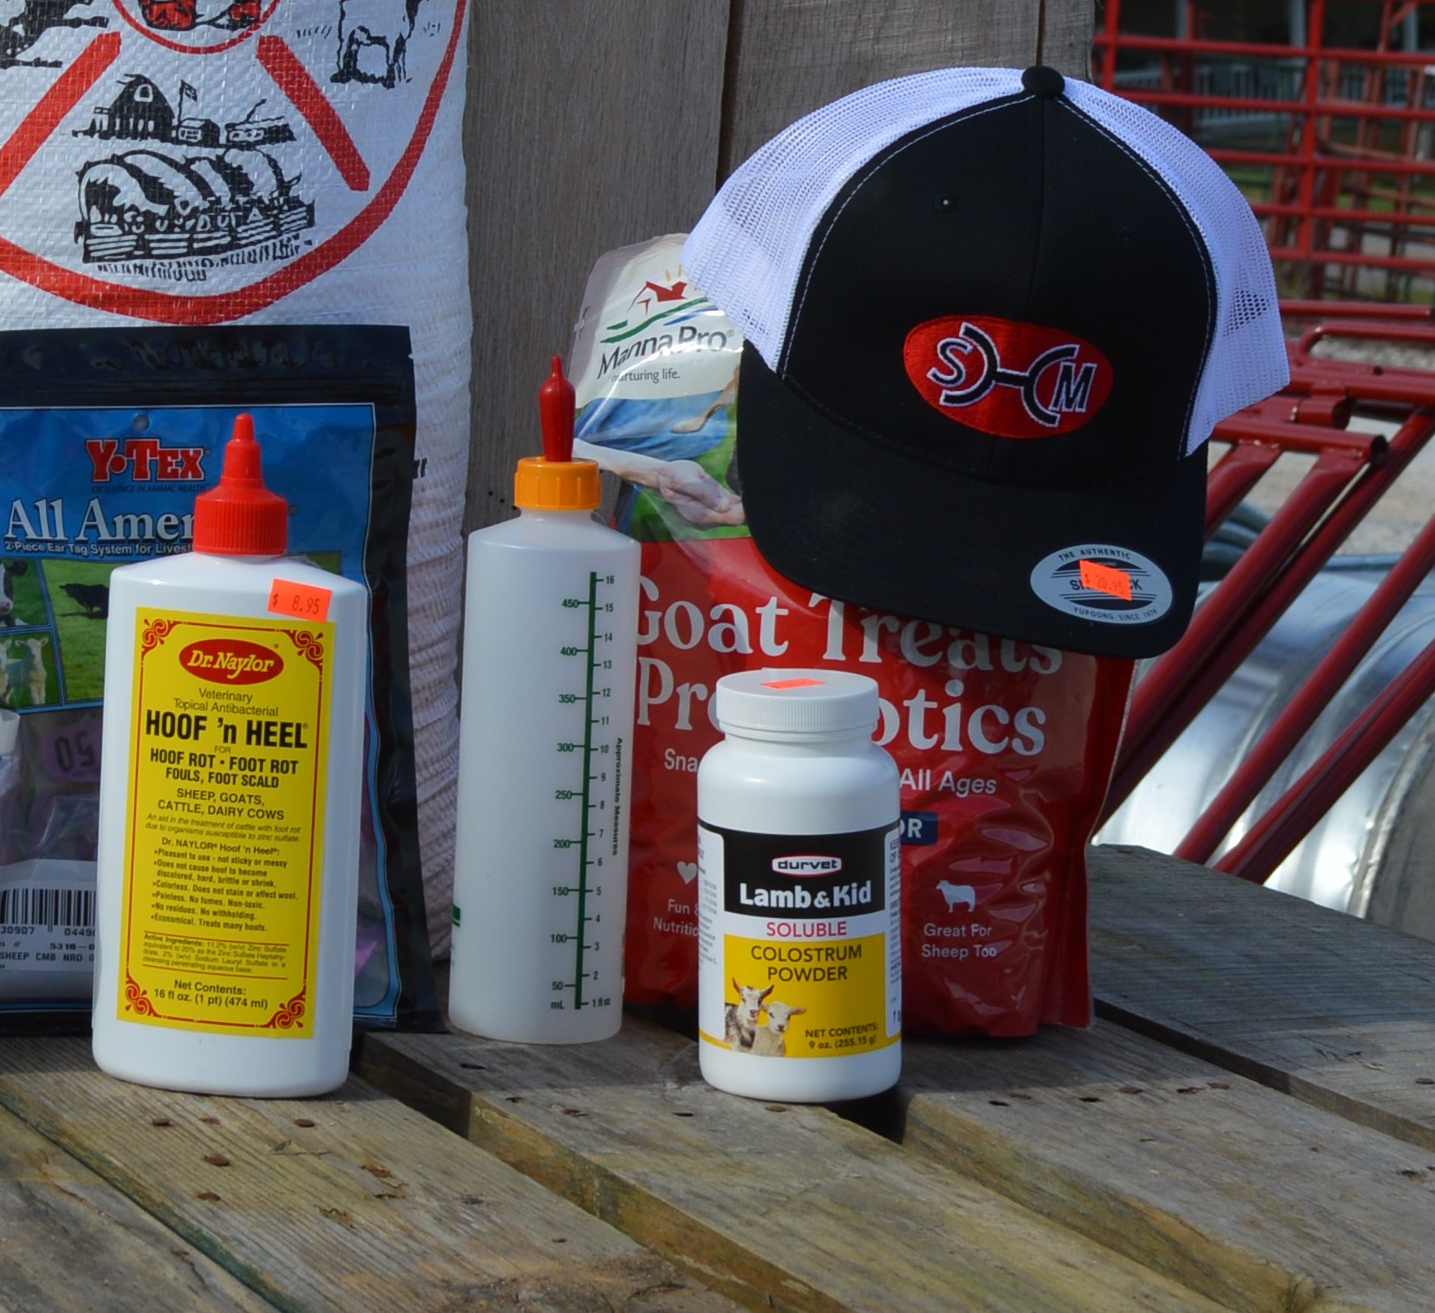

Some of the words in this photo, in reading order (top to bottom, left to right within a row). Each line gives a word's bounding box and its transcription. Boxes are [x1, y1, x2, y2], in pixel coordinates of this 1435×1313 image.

[597, 332, 672, 380] Manna
[677, 325, 727, 352] Pro
[662, 367, 680, 381] life.
[3, 498, 69, 541] All
[5, 540, 45, 553] 2-Piece
[47, 541, 65, 553] Ear
[68, 544, 88, 556] Tag
[90, 544, 132, 556] System
[135, 543, 152, 555] for
[1058, 550, 1076, 561] THE
[1080, 547, 1131, 560] AUTHENTIC
[605, 575, 615, 585] 16
[272, 592, 279, 607] $
[291, 594, 321, 616] 8.95
[561, 598, 580, 609] 450
[605, 602, 614, 612] 15
[1073, 606, 1114, 621] YUPOONG
[1118, 612, 1140, 622] SINCE
[604, 632, 613, 642] 14
[809, 593, 1063, 675] Treats
[560, 646, 578, 657] 400
[187, 646, 213, 668] Dr.
[213, 651, 275, 680] Naylor
[603, 659, 612, 669] 13
[199, 688, 253, 704] Veterinary
[558, 693, 577, 704] 350
[602, 688, 611, 698] 12
[173, 698, 208, 712] Topical
[210, 702, 279, 717] Antibacterial
[601, 716, 610, 726] 11
[146, 709, 207, 741] HOOF
[246, 720, 307, 749] HEEL
[214, 745, 231, 755] FOR
[557, 742, 574, 753] 300
[600, 744, 609, 754] 10
[150, 747, 184, 766] HOOF
[189, 752, 215, 769] ROT
[229, 756, 266, 773] FOOT
[270, 759, 299, 775] ROT
[614, 737, 623, 804] Approximate
[166, 767, 204, 785] FOULS,
[208, 771, 238, 786] FOOT
[241, 774, 280, 789] SCALD
[600, 771, 606, 782] 9
[900, 768, 931, 791] All
[938, 770, 997, 798] Ages
[177, 788, 216, 803] SHEEP,
[220, 792, 265, 807] GOATS,
[555, 789, 573, 800] 250
[158, 799, 205, 816] CATTLE,
[207, 805, 244, 818] DAIRY
[247, 808, 285, 821] COWS
[599, 799, 605, 810] 8
[598, 828, 604, 839] 7
[612, 805, 621, 856] Measures
[553, 838, 571, 849] 200
[597, 856, 603, 867] 6
[778, 859, 838, 870] durvet
[551, 886, 569, 896] 150
[596, 886, 602, 896] 5
[668, 898, 691, 915] Fun
[595, 913, 601, 923] 4
[767, 920, 847, 938] SOLUBLE
[924, 922, 967, 937] Great
[971, 923, 992, 937] For
[550, 933, 567, 944] 100
[594, 941, 600, 952] 3
[921, 943, 969, 960] Sheep
[973, 944, 997, 958] Too
[0, 951, 30, 961] SHEEP
[751, 943, 863, 963] COLOSTRUM
[593, 970, 599, 981] 2
[767, 965, 848, 982] POWDER
[174, 978, 192, 991] Net
[195, 982, 247, 996] Contents:
[551, 980, 564, 991] 50
[154, 988, 166, 999] 16
[168, 990, 175, 1000] fl
[177, 993, 192, 1002] oz.
[195, 993, 205, 1005] (1
[208, 995, 223, 1007] pt)
[225, 996, 248, 1009] (474
[250, 998, 269, 1011] ml)
[550, 1000, 565, 1010] mL
[805, 1028, 826, 1038] NET
[808, 1040, 815, 1049] 9
[818, 1041, 832, 1049] oz.
